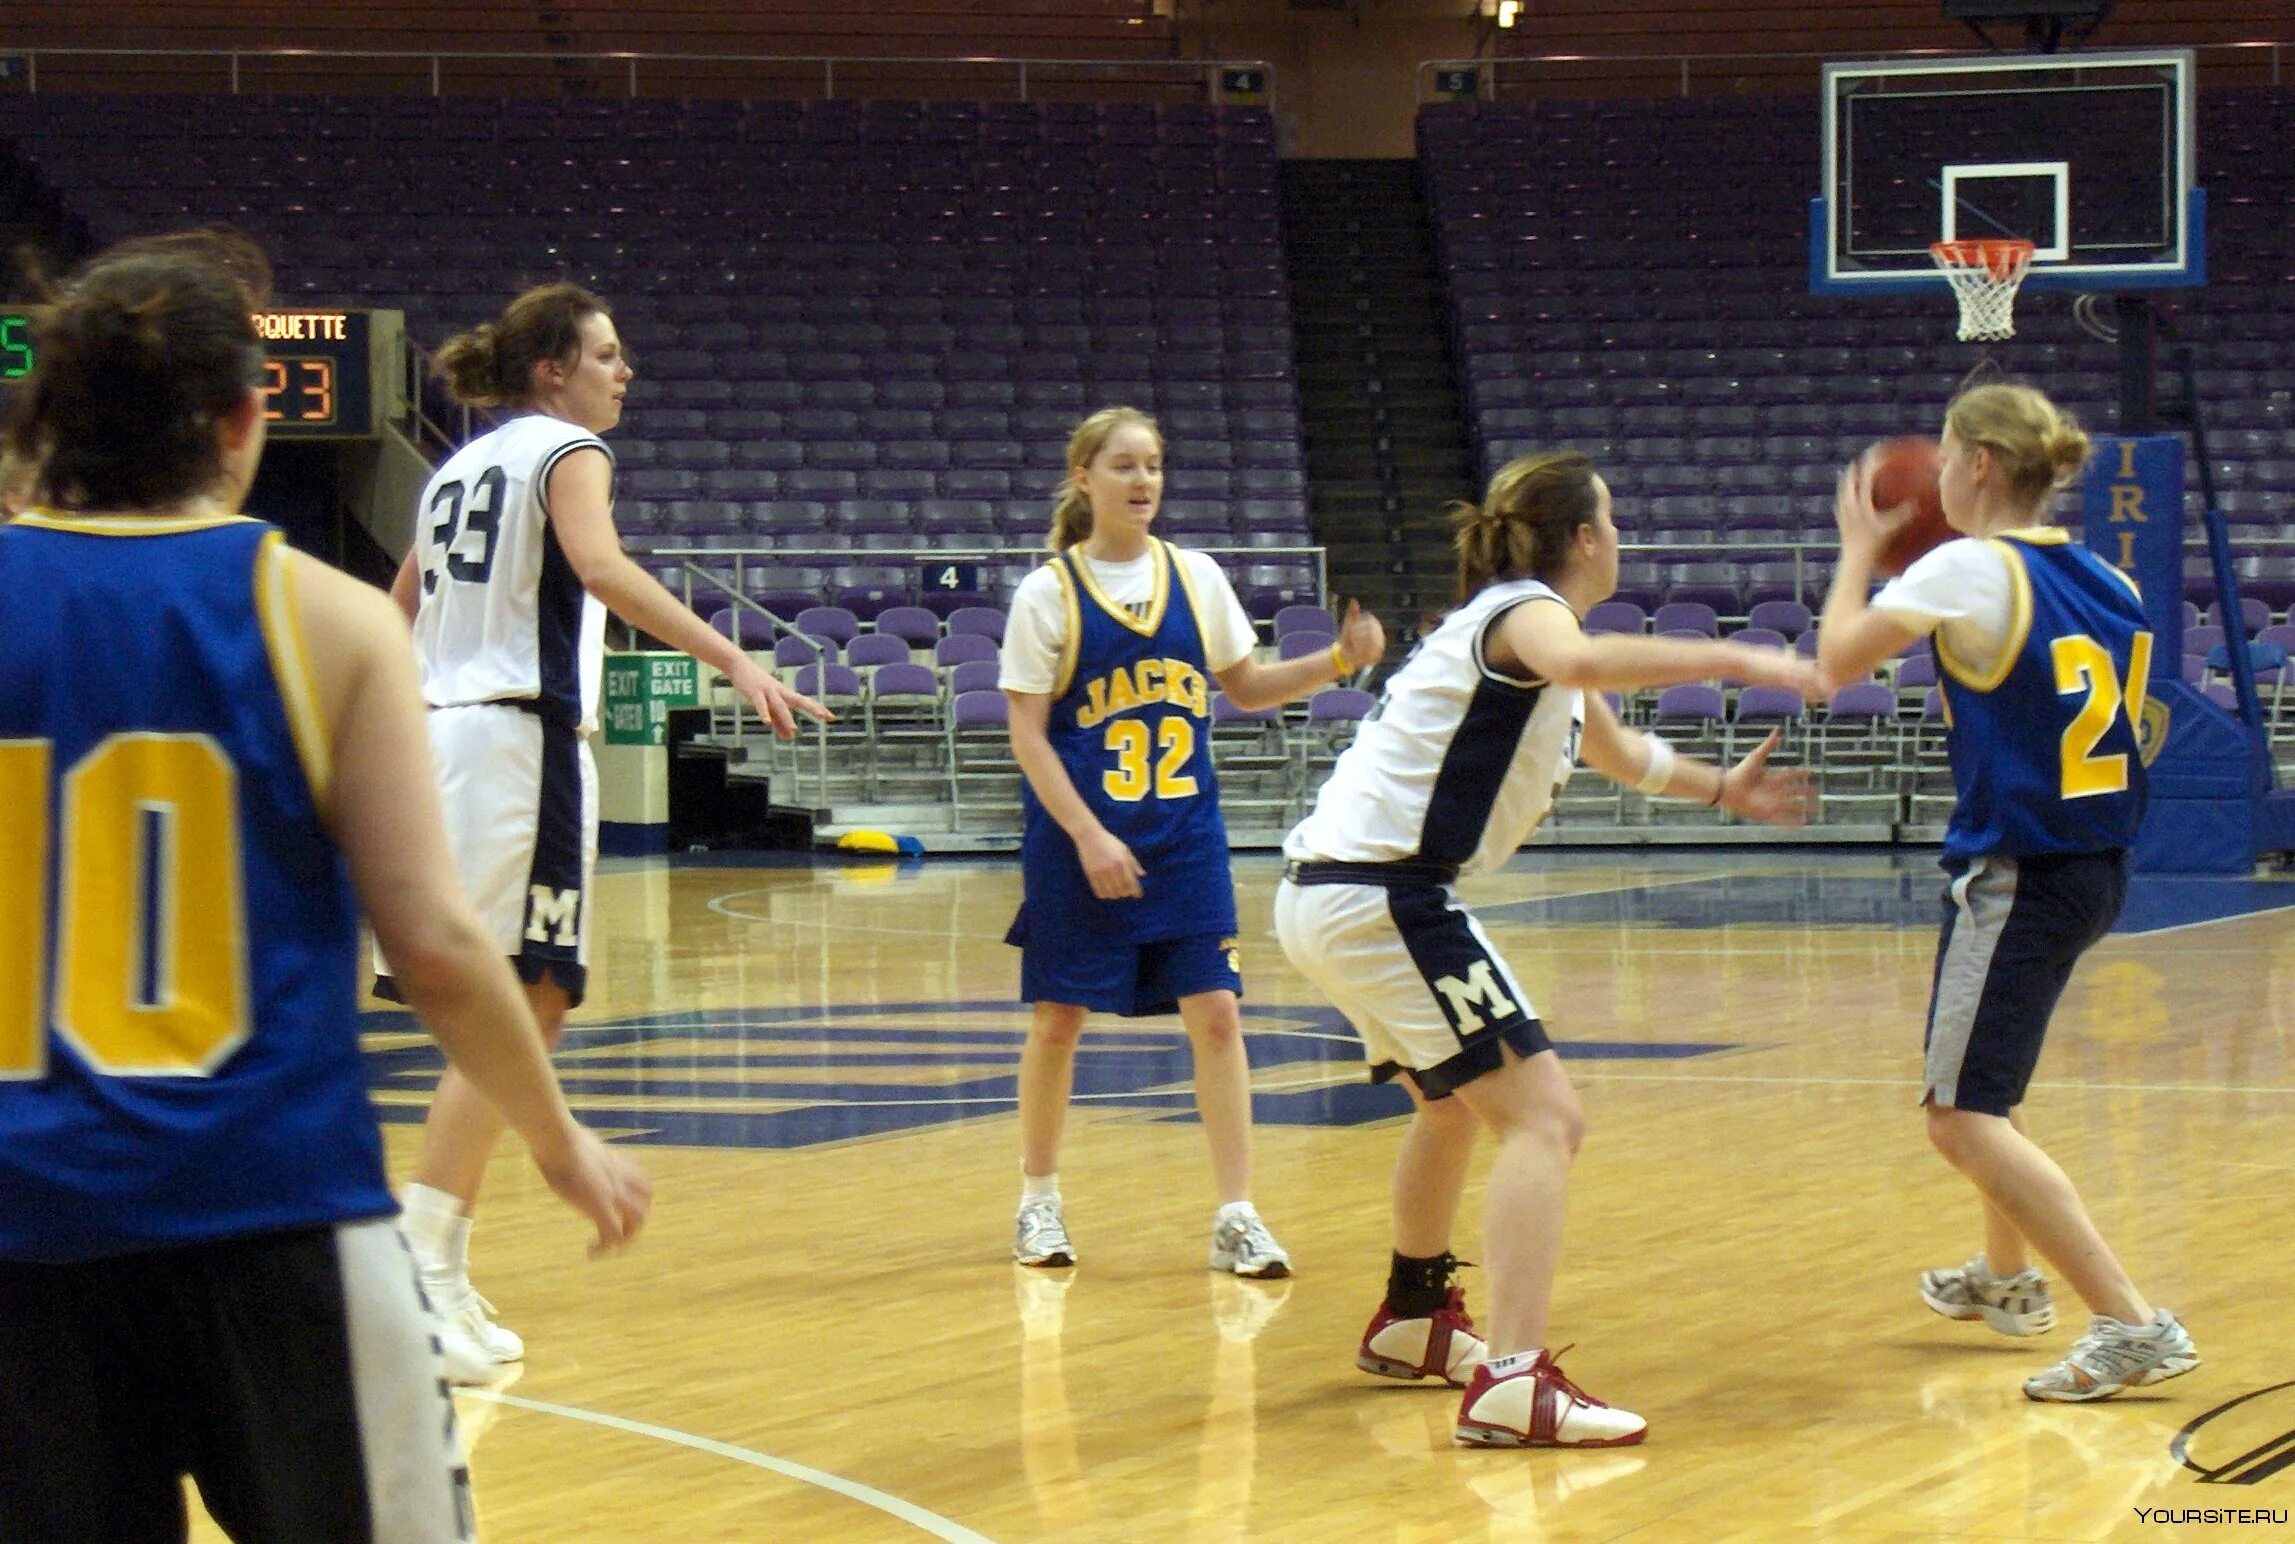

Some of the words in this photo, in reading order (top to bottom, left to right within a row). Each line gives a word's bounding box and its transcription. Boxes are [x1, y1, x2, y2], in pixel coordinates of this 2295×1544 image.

[1235, 73, 1250, 89] 4
[1, 319, 33, 377] 5
[262, 362, 330, 419] 23
[423, 465, 507, 596] 33
[939, 566, 960, 589] 4
[608, 671, 639, 697] EXIT
[651, 679, 693, 695] GATE
[652, 661, 690, 677] EXIT
[1076, 657, 1208, 729] JACKS
[1102, 715, 1199, 802] 32
[525, 885, 579, 946] M
[1434, 960, 1519, 1036] M
